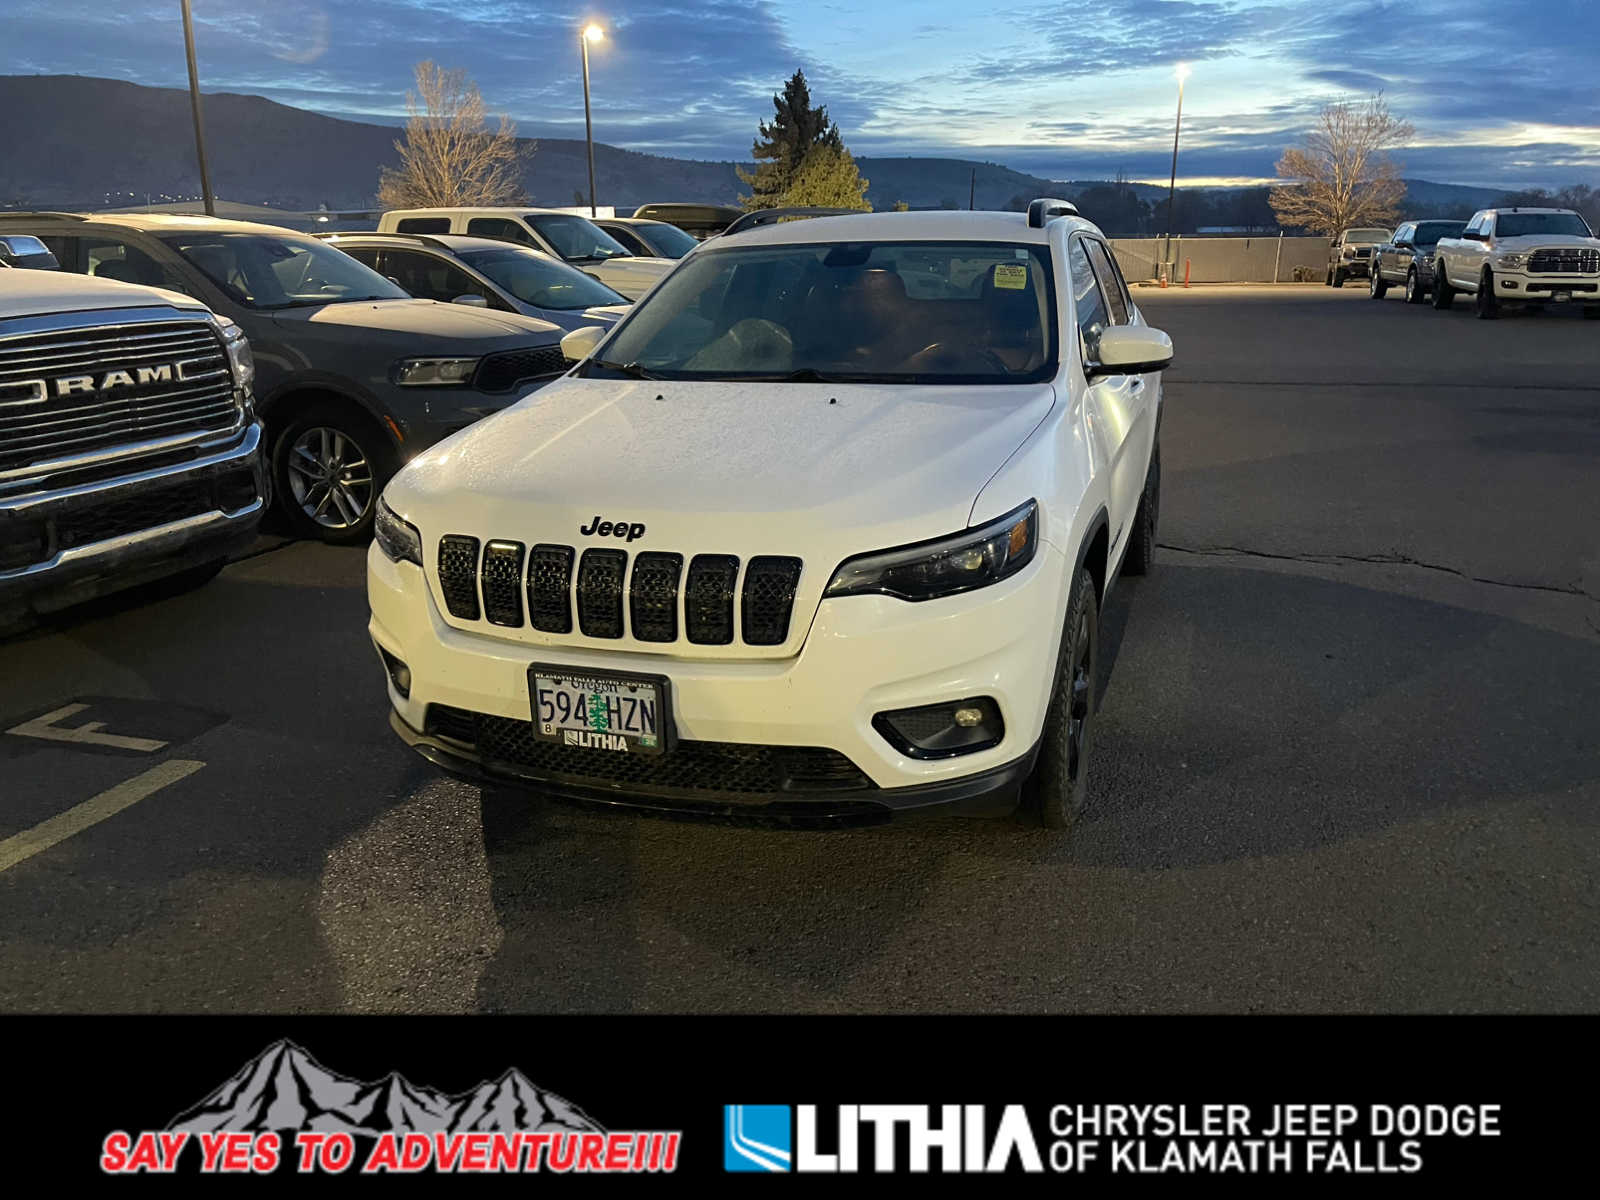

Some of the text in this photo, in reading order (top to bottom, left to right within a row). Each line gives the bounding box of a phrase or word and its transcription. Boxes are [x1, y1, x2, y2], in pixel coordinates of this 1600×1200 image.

[56, 364, 172, 396] RAM
[580, 516, 646, 542] Jeep
[538, 688, 656, 734] 594 HZN
[578, 731, 629, 752] LITHIA
